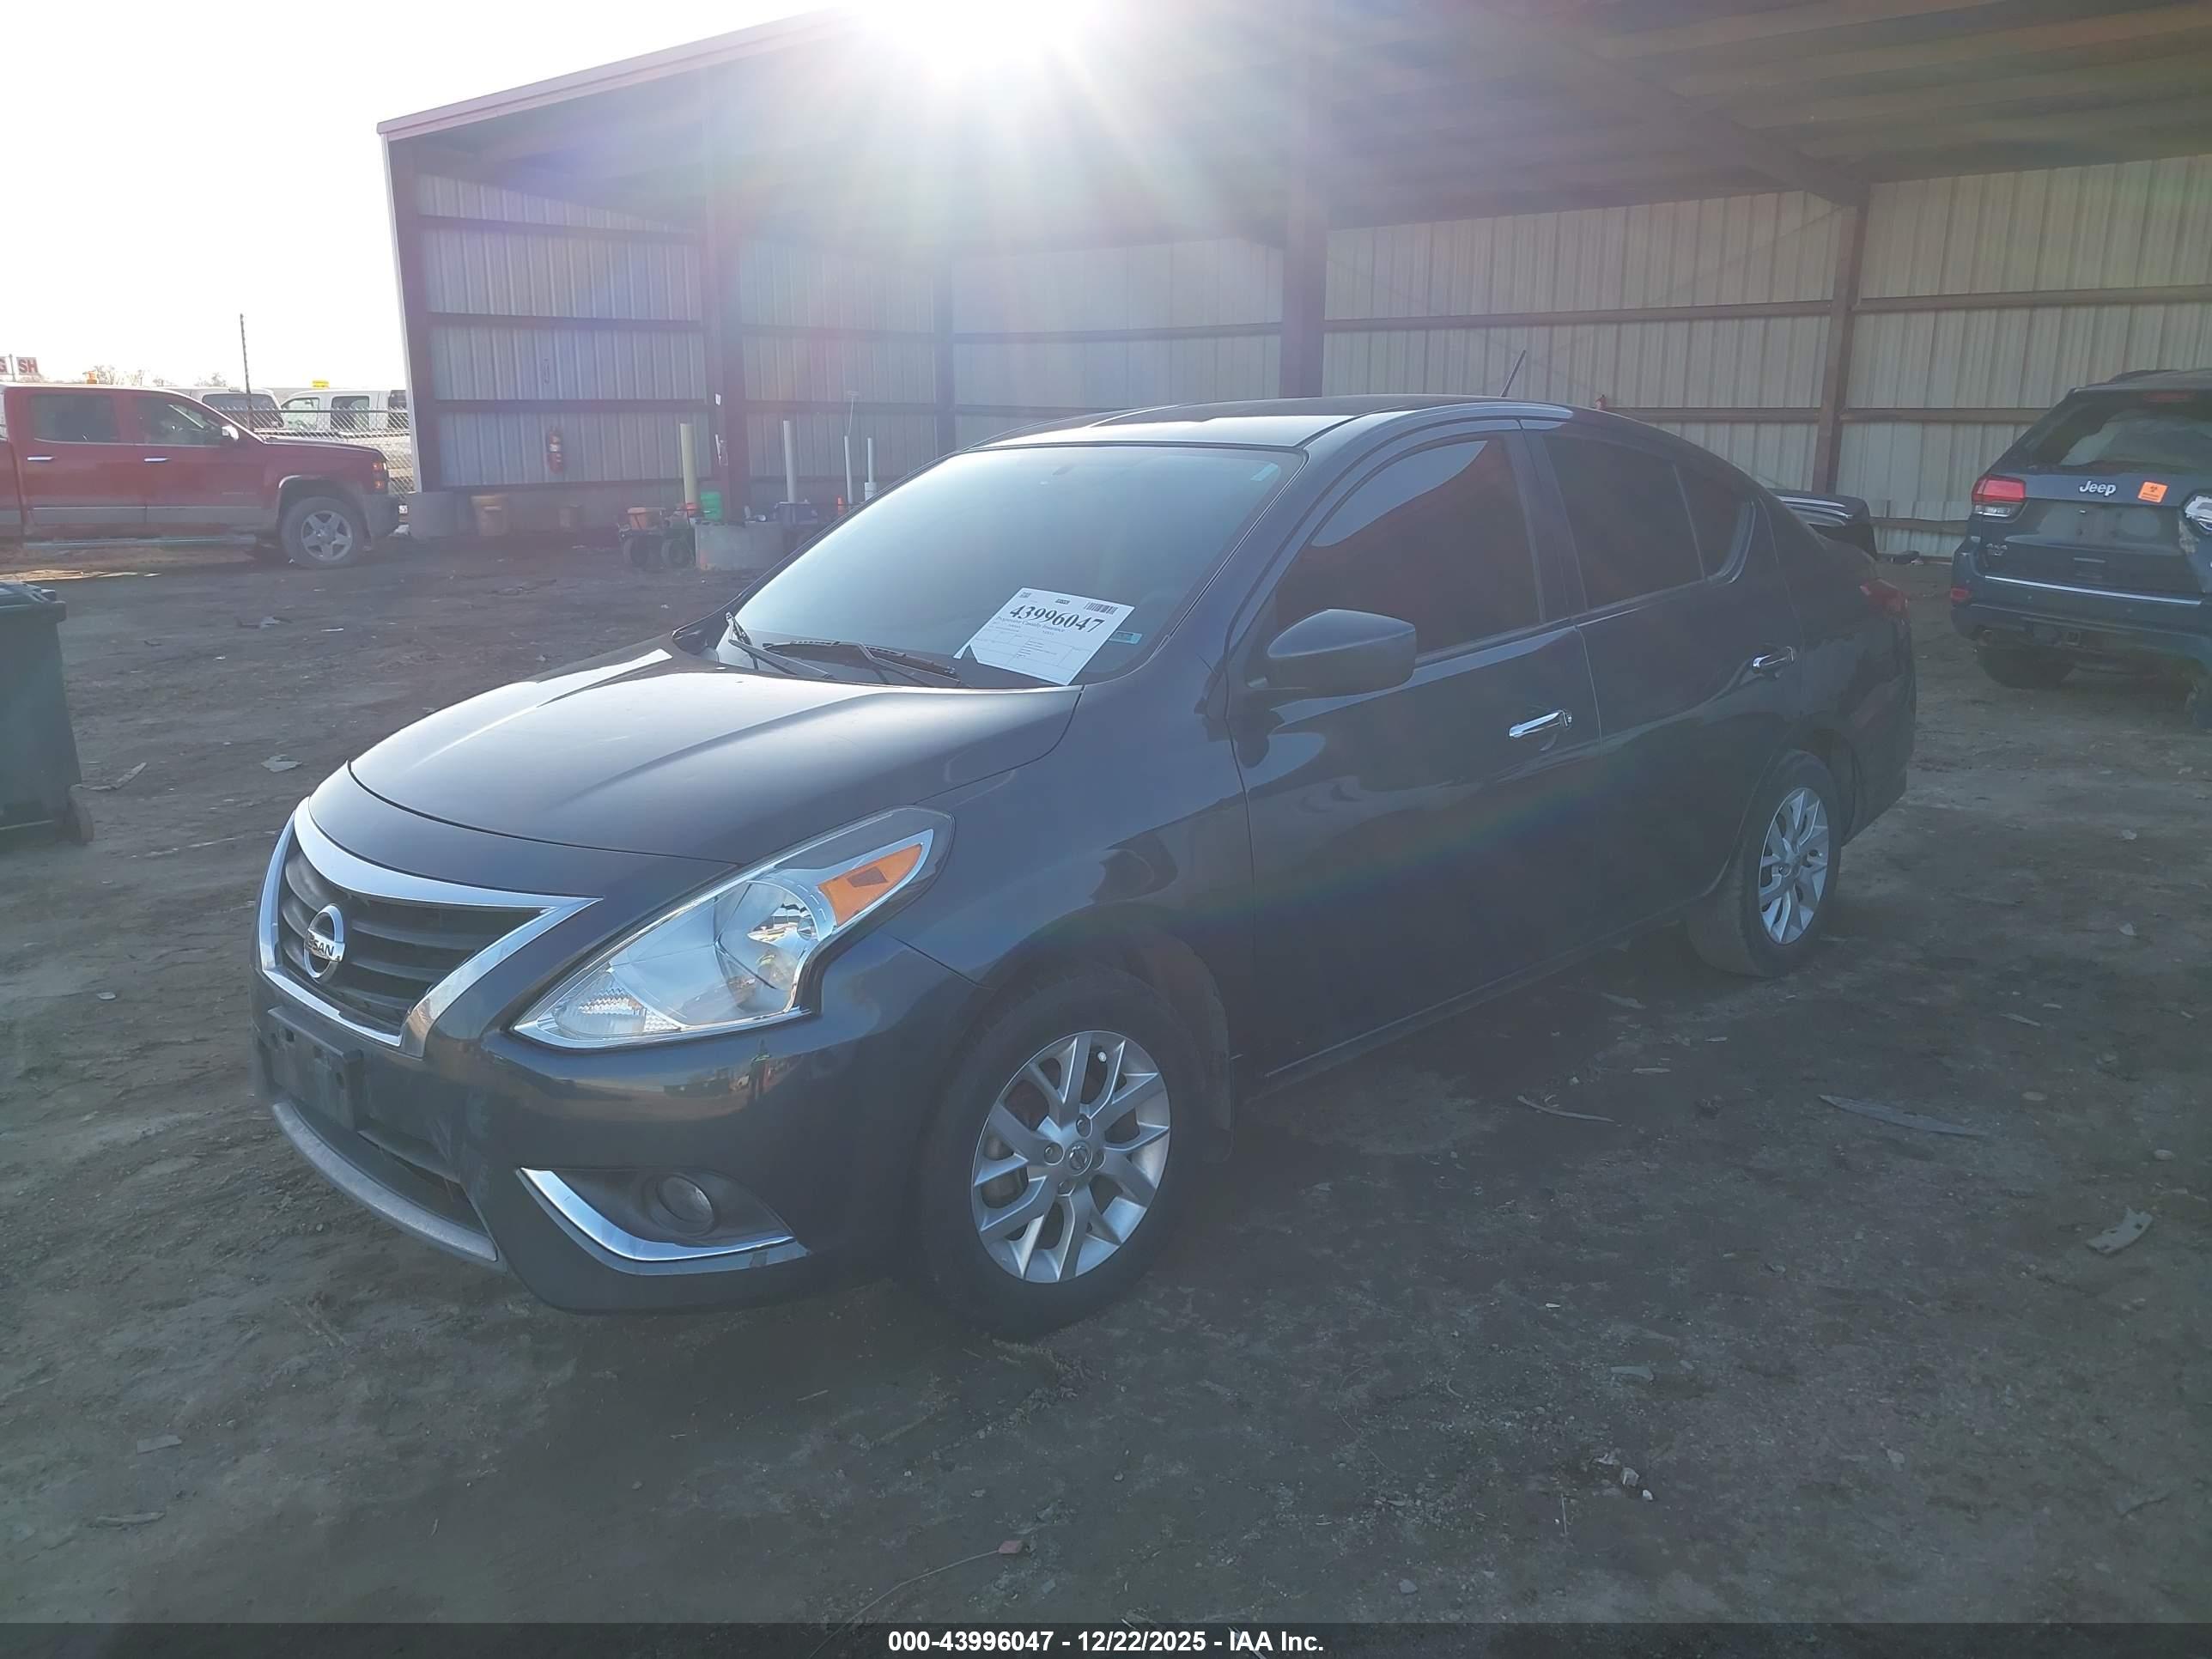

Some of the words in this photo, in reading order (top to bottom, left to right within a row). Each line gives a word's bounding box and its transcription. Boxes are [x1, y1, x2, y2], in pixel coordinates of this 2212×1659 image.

[2079, 480, 2117, 496] Jeep
[1010, 605, 1105, 633] 43996047
[306, 933, 335, 957] SSAN
